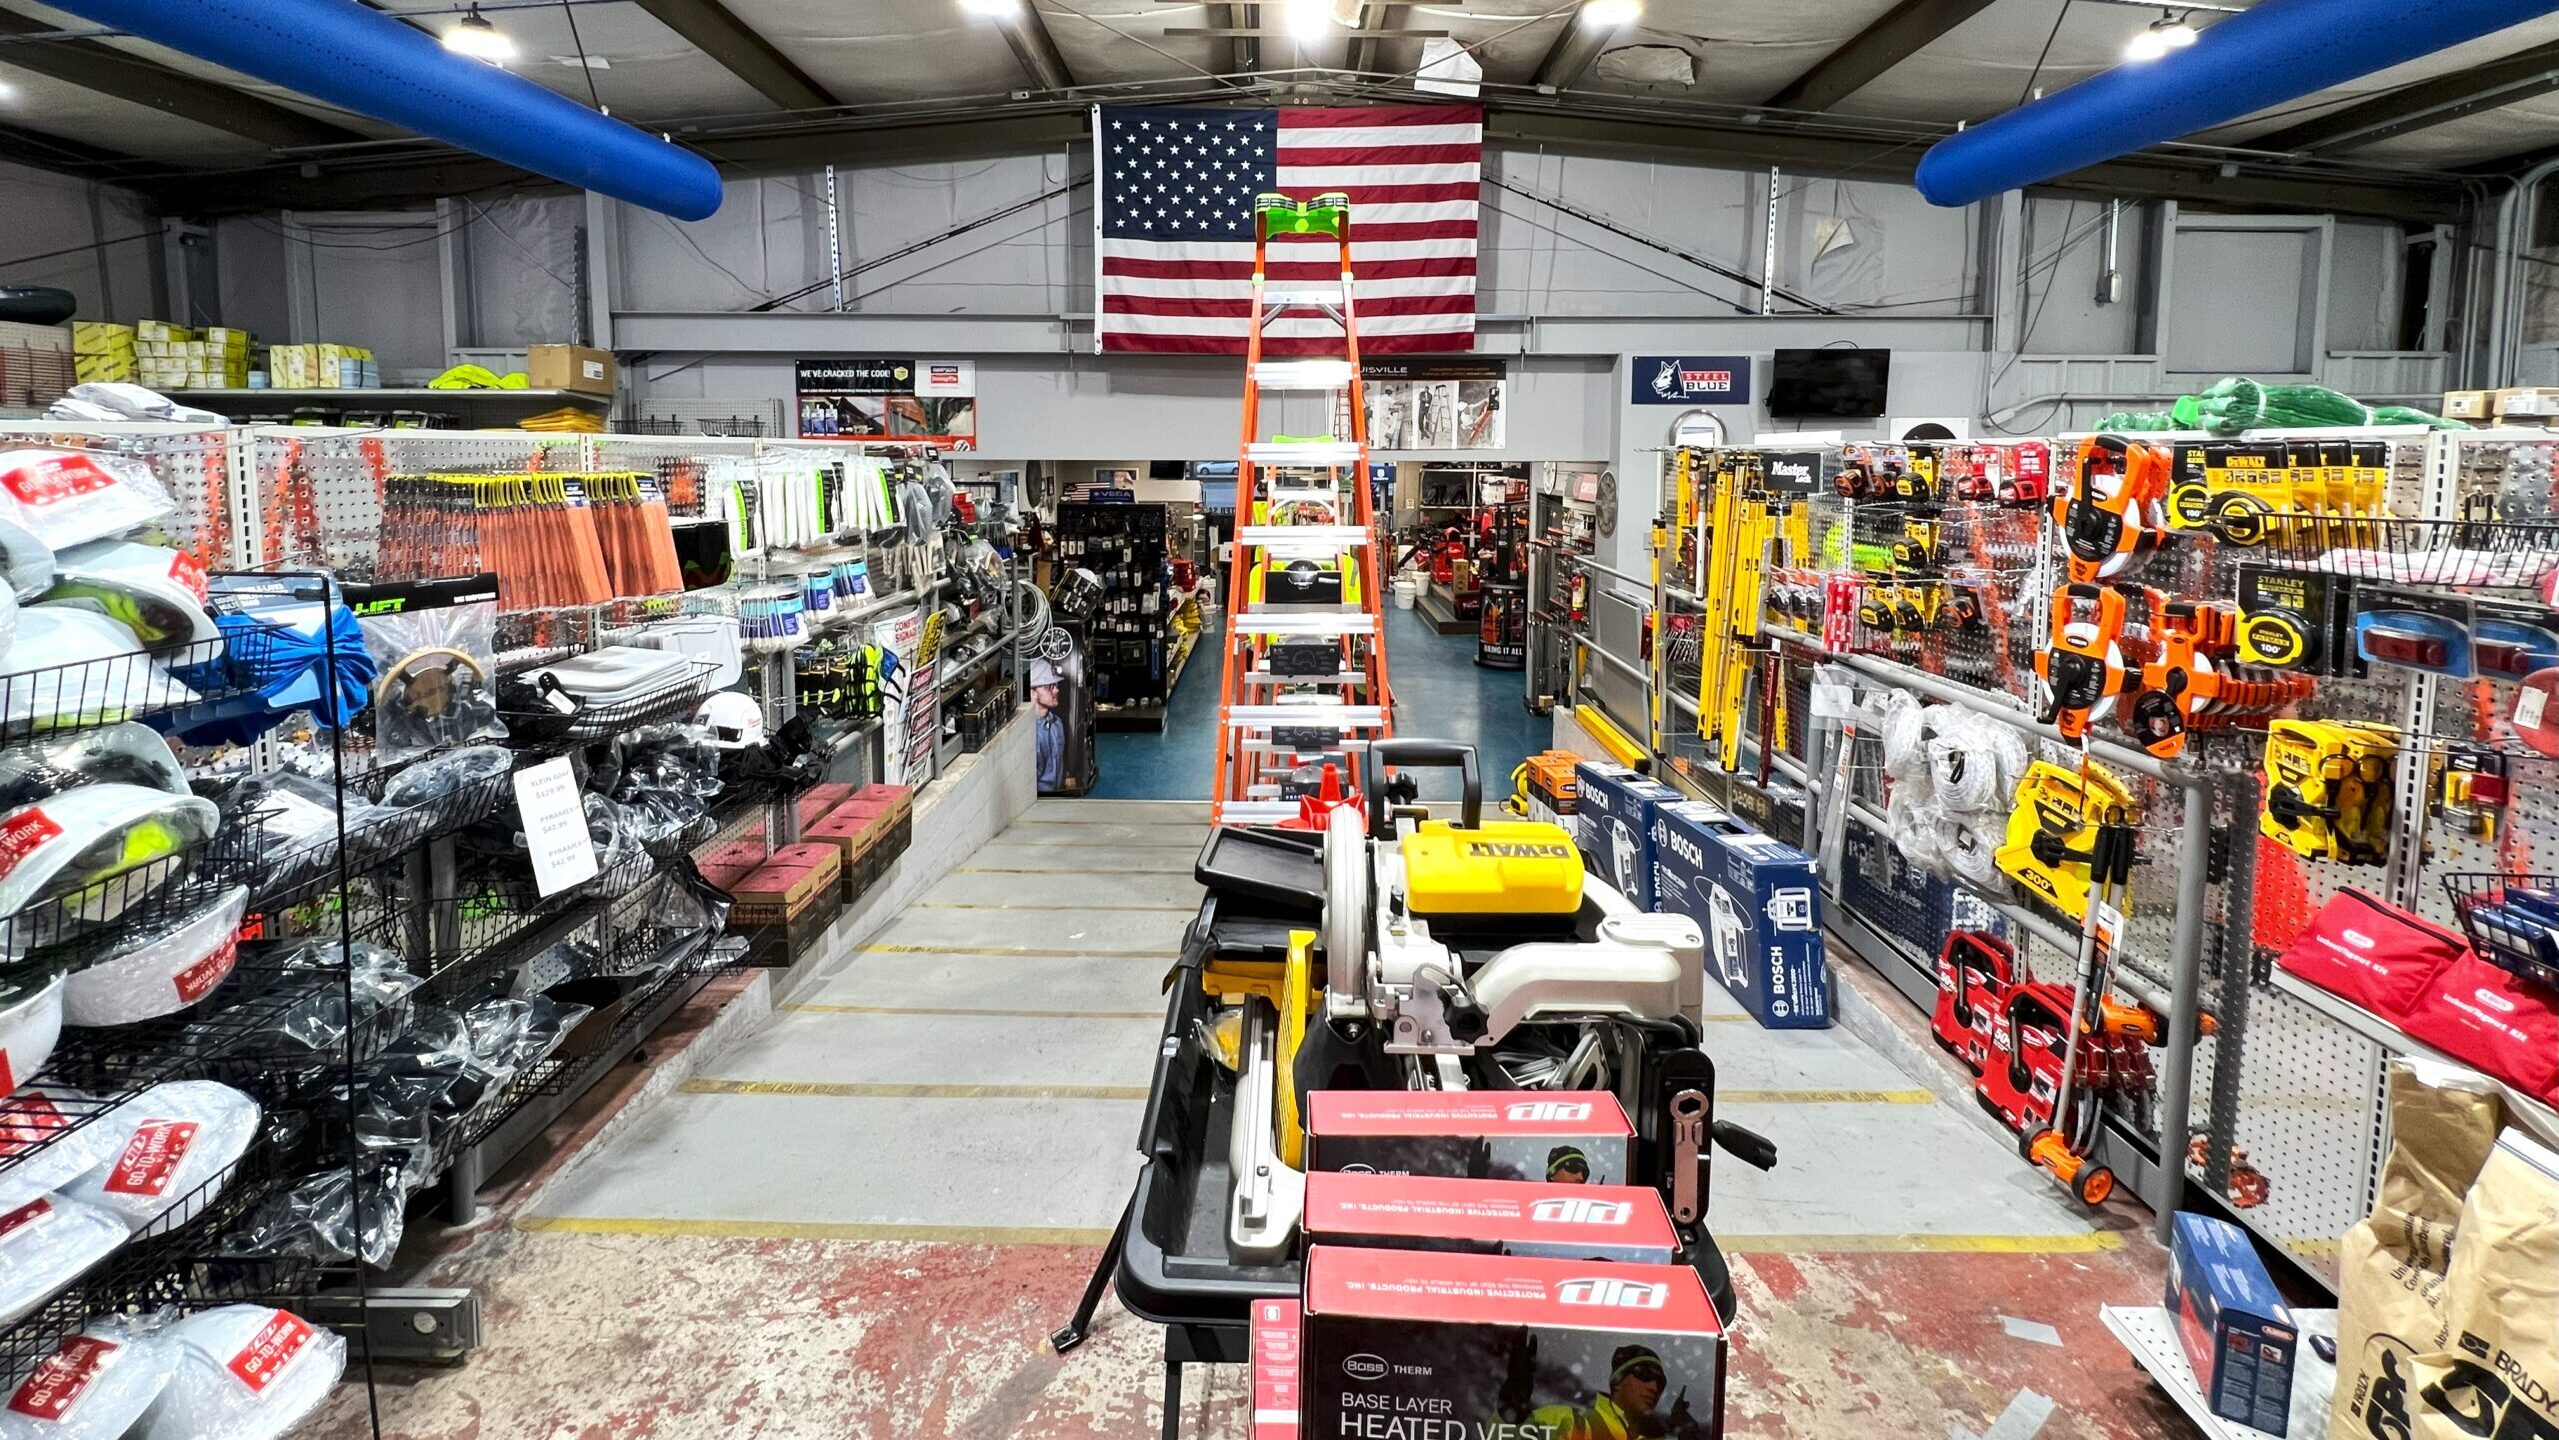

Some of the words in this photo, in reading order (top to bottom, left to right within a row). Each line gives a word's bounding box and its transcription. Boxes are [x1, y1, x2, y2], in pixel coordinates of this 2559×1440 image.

[800, 369, 822, 378] WE'VE
[823, 369, 853, 378] CRACKED
[856, 369, 869, 378] THE
[870, 369, 891, 378] CODE!
[1686, 372, 1728, 381] STEEL
[1686, 381, 1728, 390] BLUE
[1771, 461, 1809, 476] Master
[2257, 575, 2304, 588] STANLEY
[355, 598, 405, 613] LIFT
[1503, 646, 1510, 655] IT
[1511, 646, 1522, 655] ALL
[1585, 782, 1609, 811] BOSCH
[1671, 829, 1703, 871] BOSCH
[1772, 945, 1785, 995] BOSCH
[2372, 962, 2389, 976] Kit
[2509, 1026, 2529, 1042] Kit
[126, 1125, 174, 1186] GO-TO-WORK
[1411, 1205, 1464, 1215] INDUSTRIAL
[1467, 1207, 1521, 1217] PROTECTIVE
[1345, 1280, 1365, 1289] INC.
[1426, 1286, 1484, 1296] INDUSTRIAL
[1487, 1289, 1546, 1299] PROTECTIVE
[244, 1321, 296, 1375] GO-TO-WORK
[28, 1342, 92, 1408] GO-TO-WORK
[1393, 1364, 1433, 1376] THERM
[2494, 1349, 2559, 1418] BRADY
[1341, 1392, 1390, 1410] BASE
[1395, 1395, 1453, 1415] LAYER
[1340, 1411, 1466, 1440] HEATED
[1476, 1421, 1559, 1440] VEST
